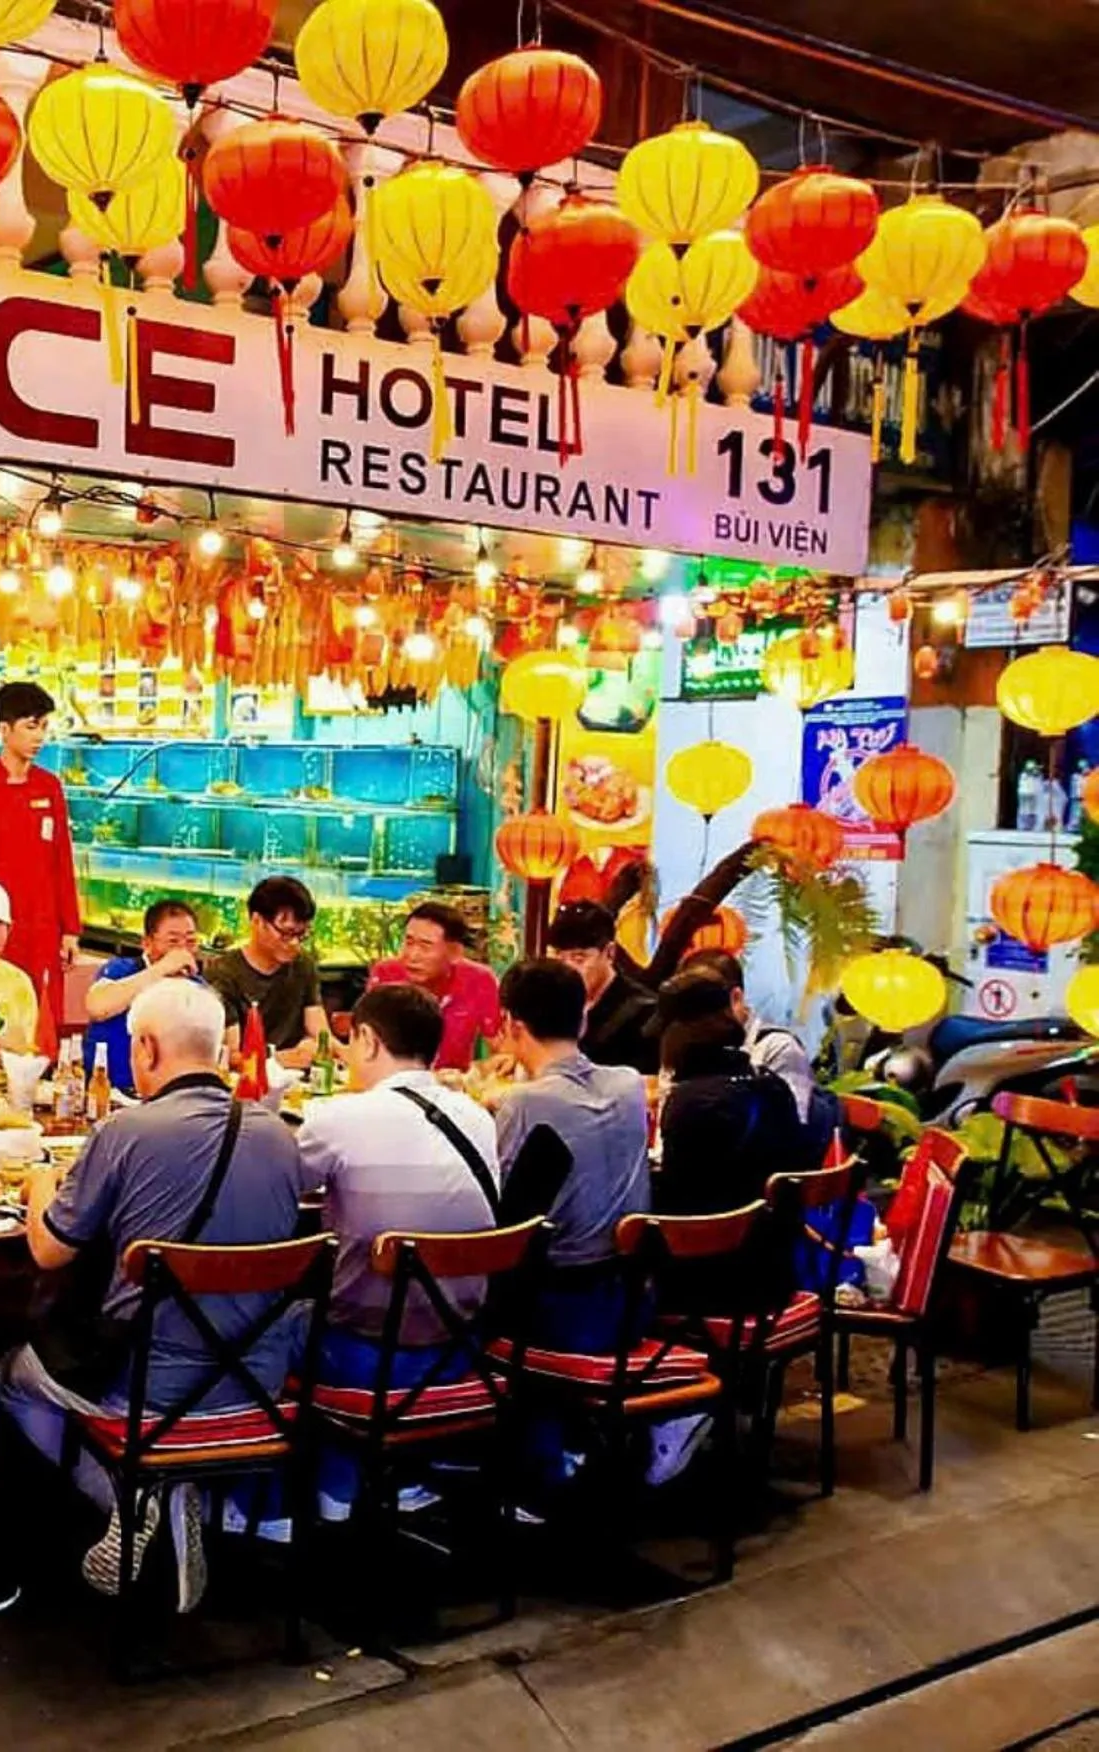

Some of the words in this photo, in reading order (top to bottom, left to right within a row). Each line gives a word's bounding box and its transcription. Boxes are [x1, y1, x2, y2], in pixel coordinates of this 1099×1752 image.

[320, 353, 582, 456] HOTEL
[320, 438, 660, 531] RESTAURANT
[716, 429, 832, 514] 131
[768, 520, 827, 557] VIỆN
